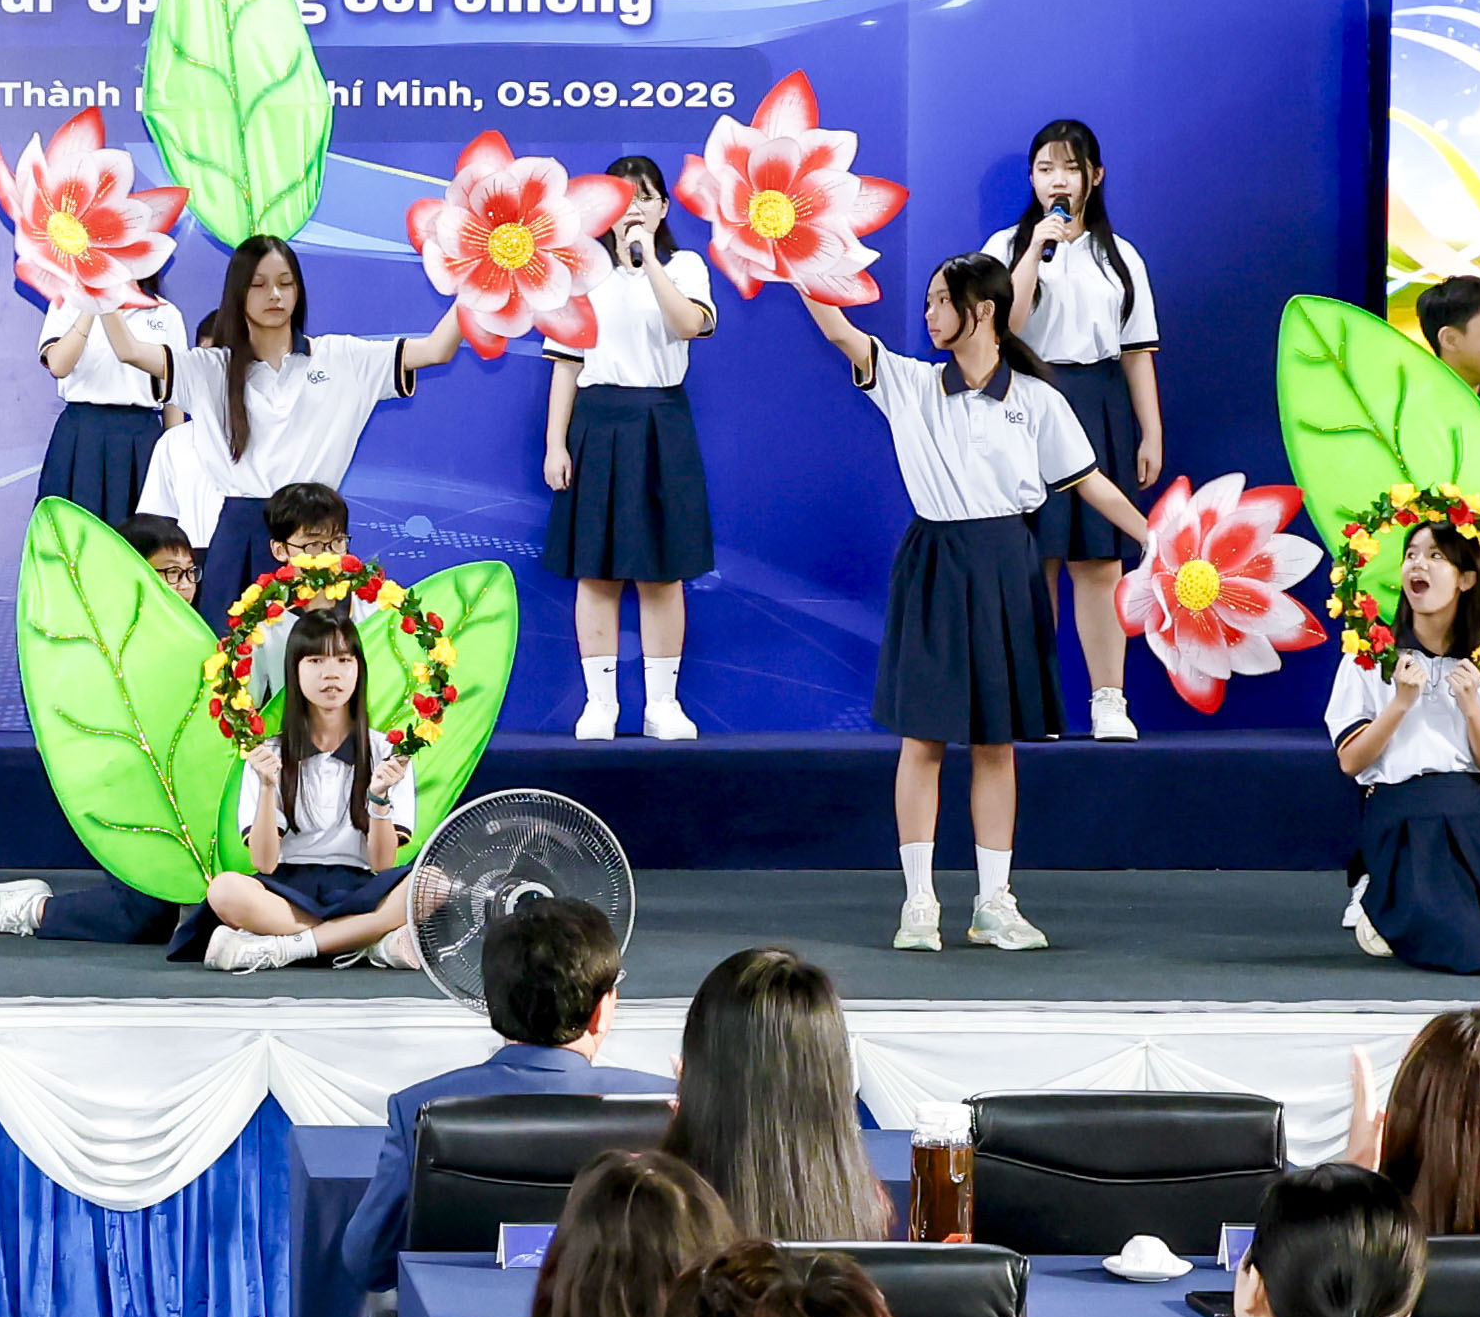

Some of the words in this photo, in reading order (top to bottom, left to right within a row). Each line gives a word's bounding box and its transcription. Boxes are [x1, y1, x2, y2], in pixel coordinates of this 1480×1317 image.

[327, 80, 362, 108] hí
[378, 80, 485, 114] Minh,
[498, 81, 737, 110] 05.09.2026
